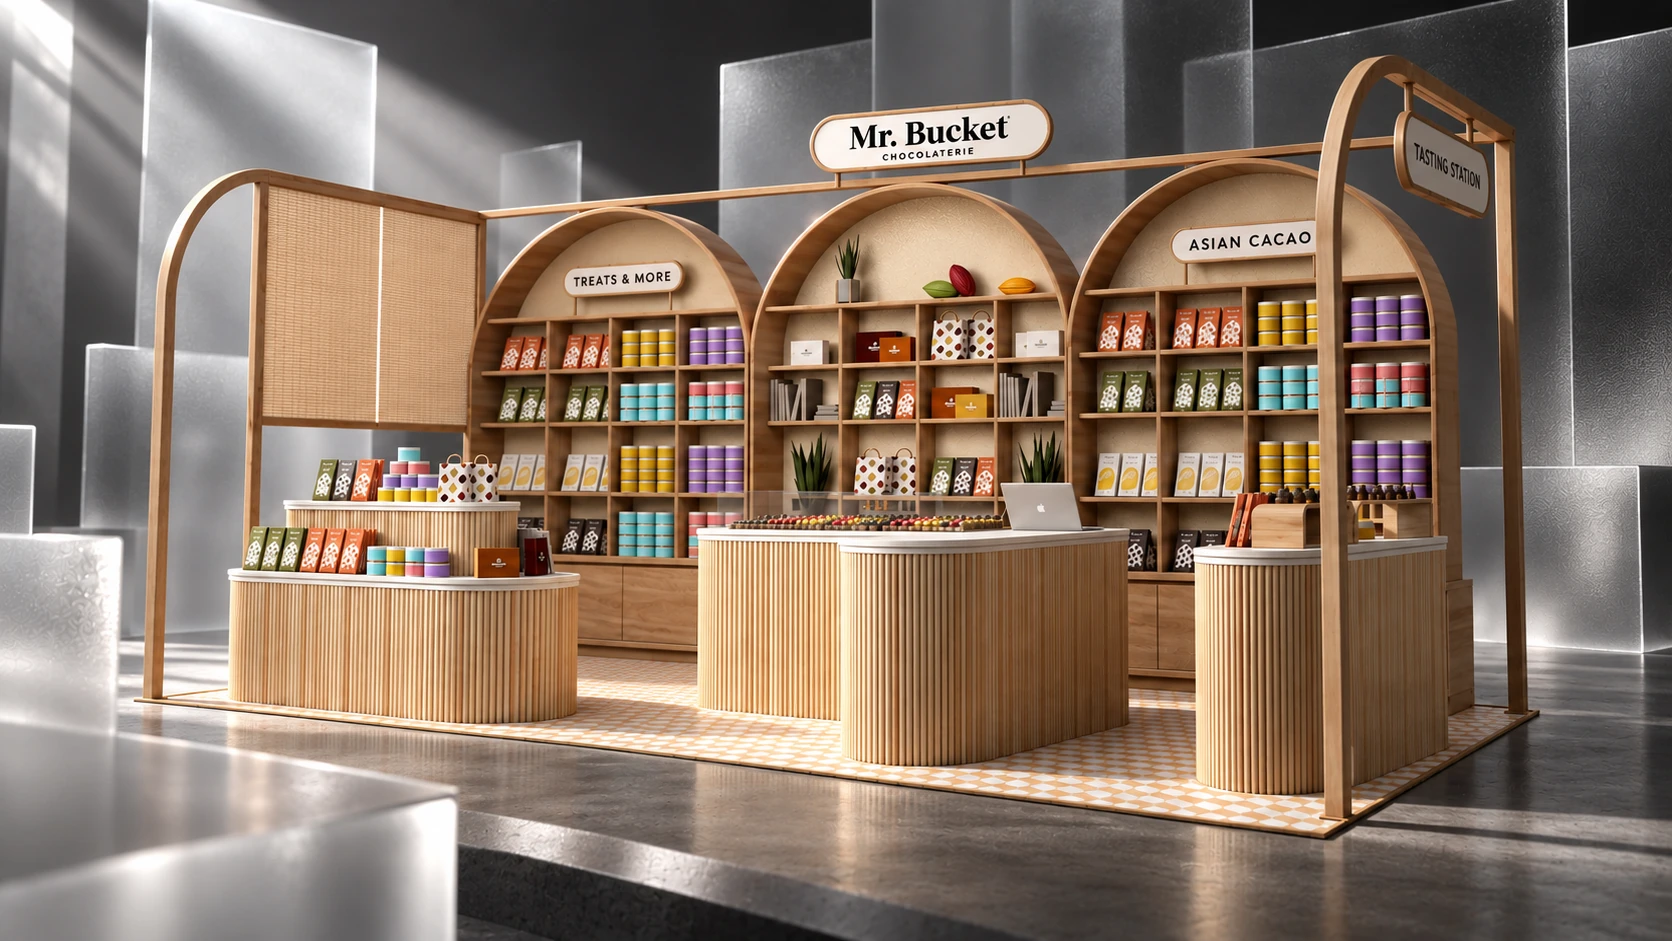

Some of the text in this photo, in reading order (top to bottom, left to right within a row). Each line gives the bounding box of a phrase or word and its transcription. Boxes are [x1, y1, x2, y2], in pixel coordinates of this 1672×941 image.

[849, 115, 1009, 150] Mr. Bucket
[882, 147, 974, 161] CHOCOLATERIE
[1413, 142, 1481, 190] TASTING STATION
[1189, 231, 1311, 251] ASIAN CACAO
[573, 271, 671, 287] TREATS & MORE
